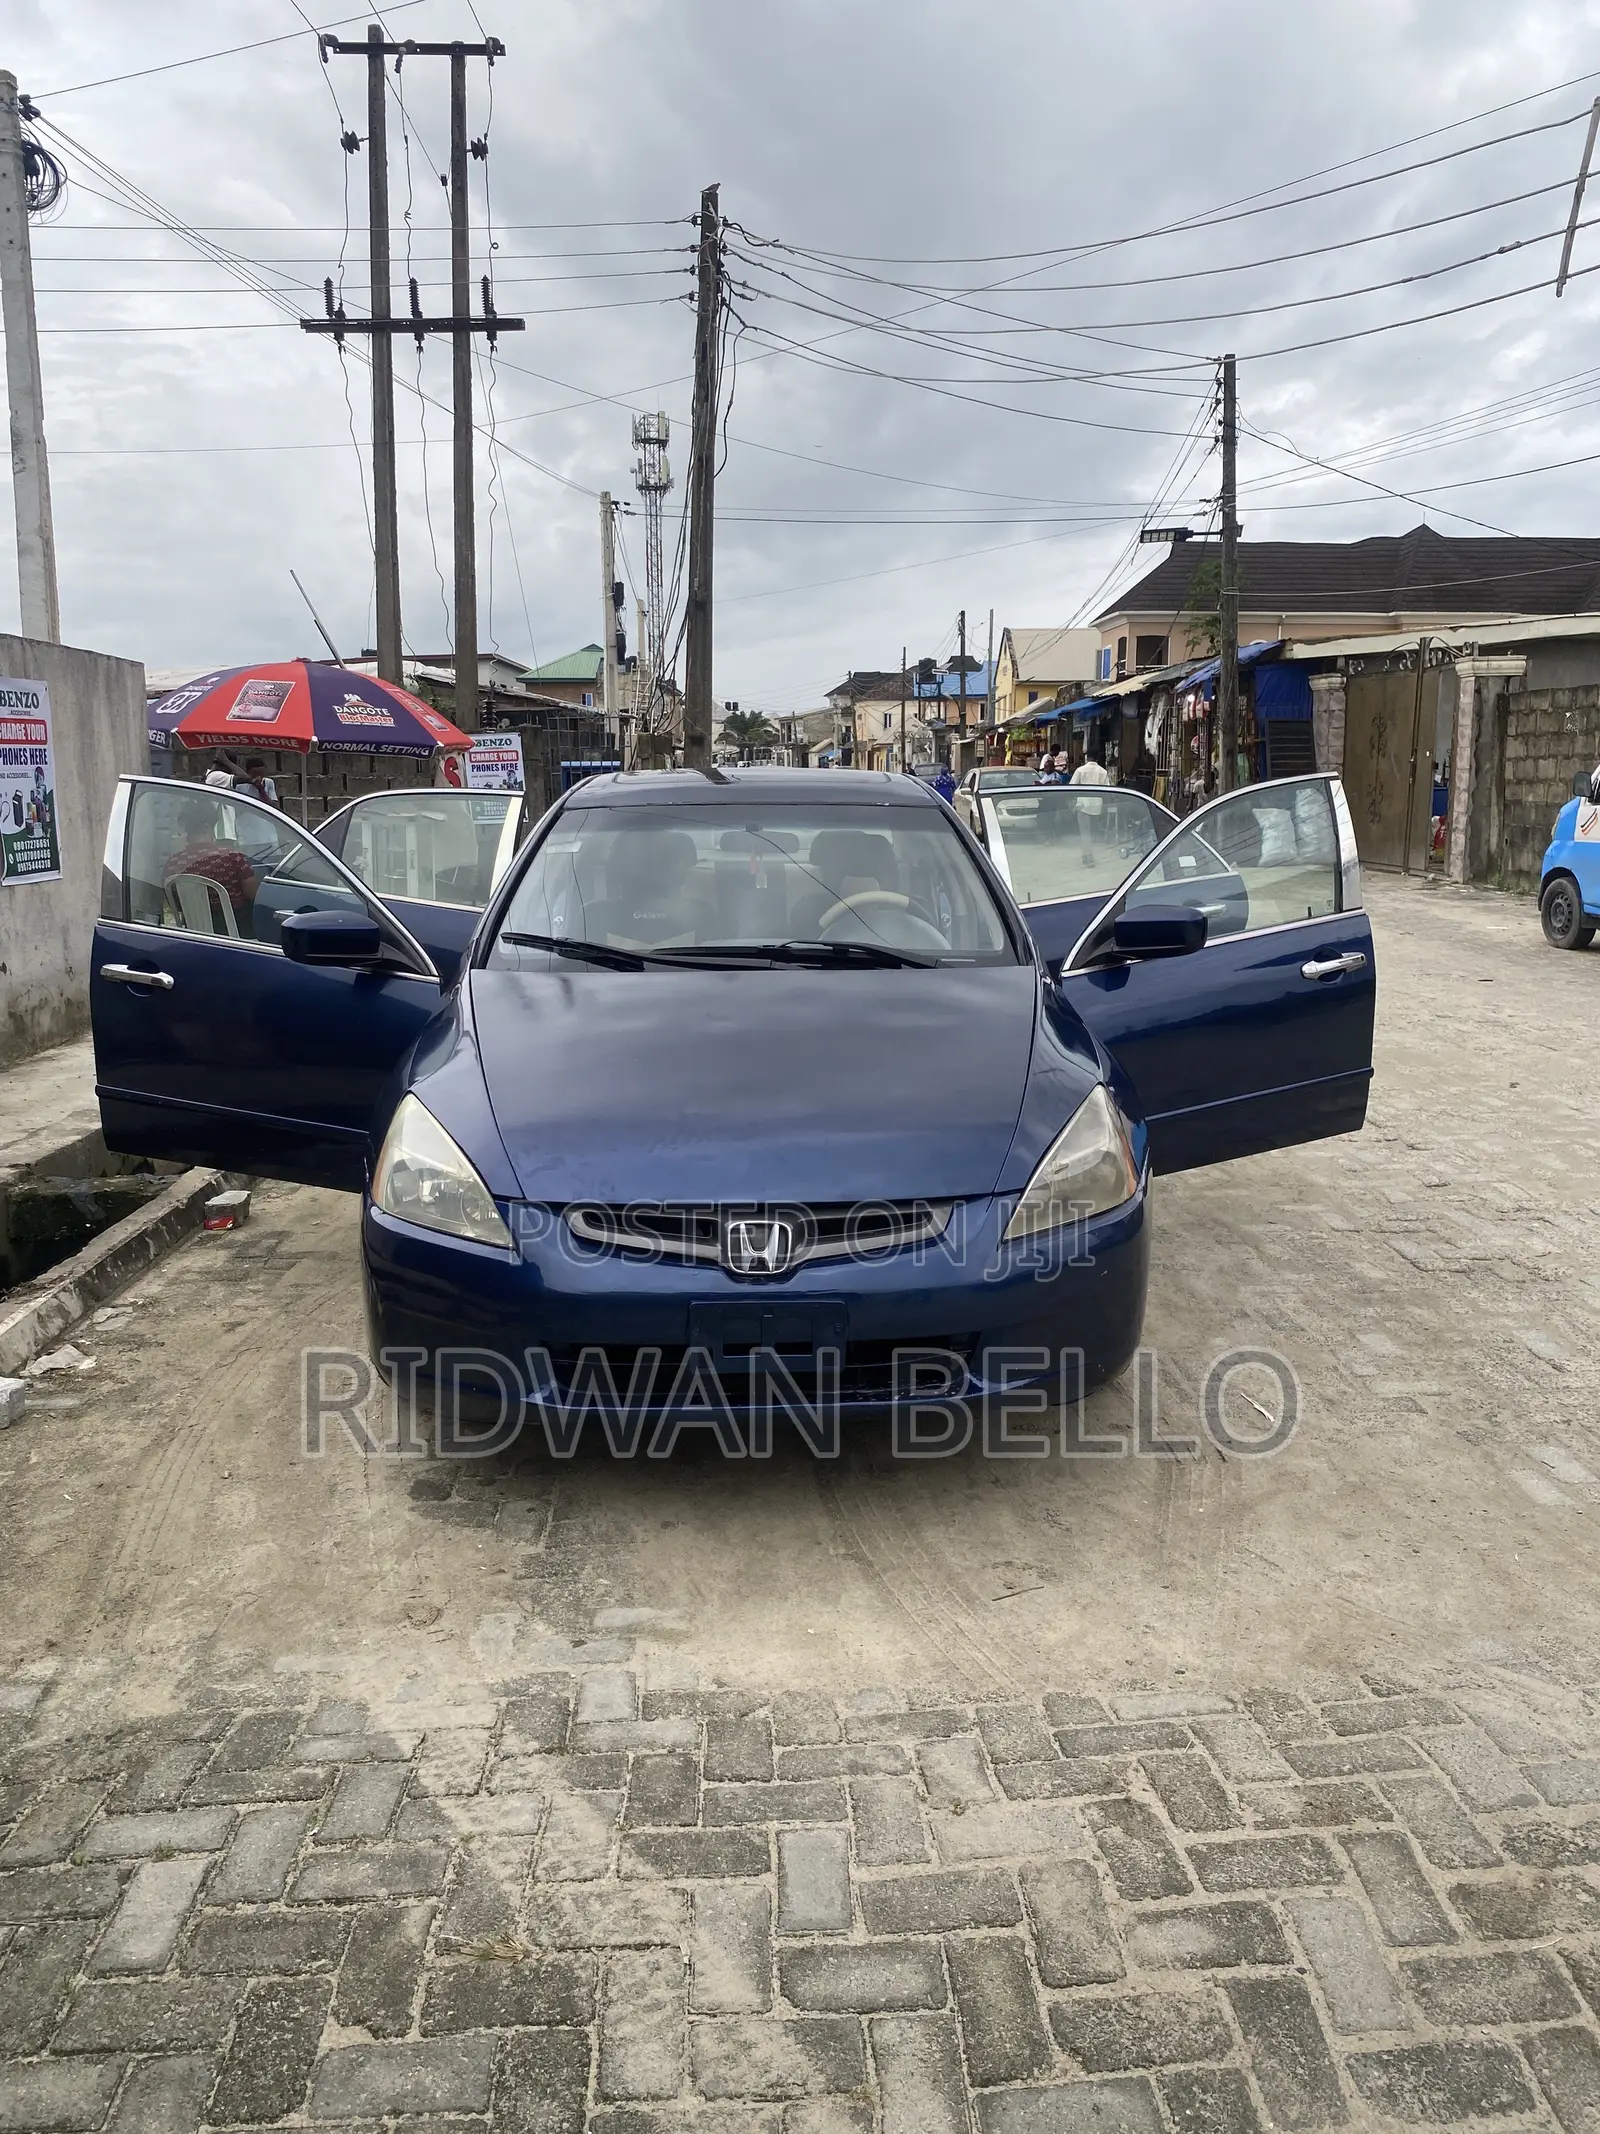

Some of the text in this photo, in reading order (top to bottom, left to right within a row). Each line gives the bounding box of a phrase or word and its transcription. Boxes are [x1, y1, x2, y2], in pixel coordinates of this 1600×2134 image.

[0, 690, 39, 709] BENZO
[332, 705, 390, 716] DANGOTE
[337, 713, 394, 724] BlocMaster
[26, 723, 46, 741] YOUR
[196, 734, 299, 748] YIELDS MORE
[475, 738, 512, 747] BENZO
[322, 742, 429, 756] NORMAL SETTING
[29, 747, 48, 766] HERE
[471, 752, 517, 761] CHARGE YOUR
[471, 763, 519, 772] PHONES HERE
